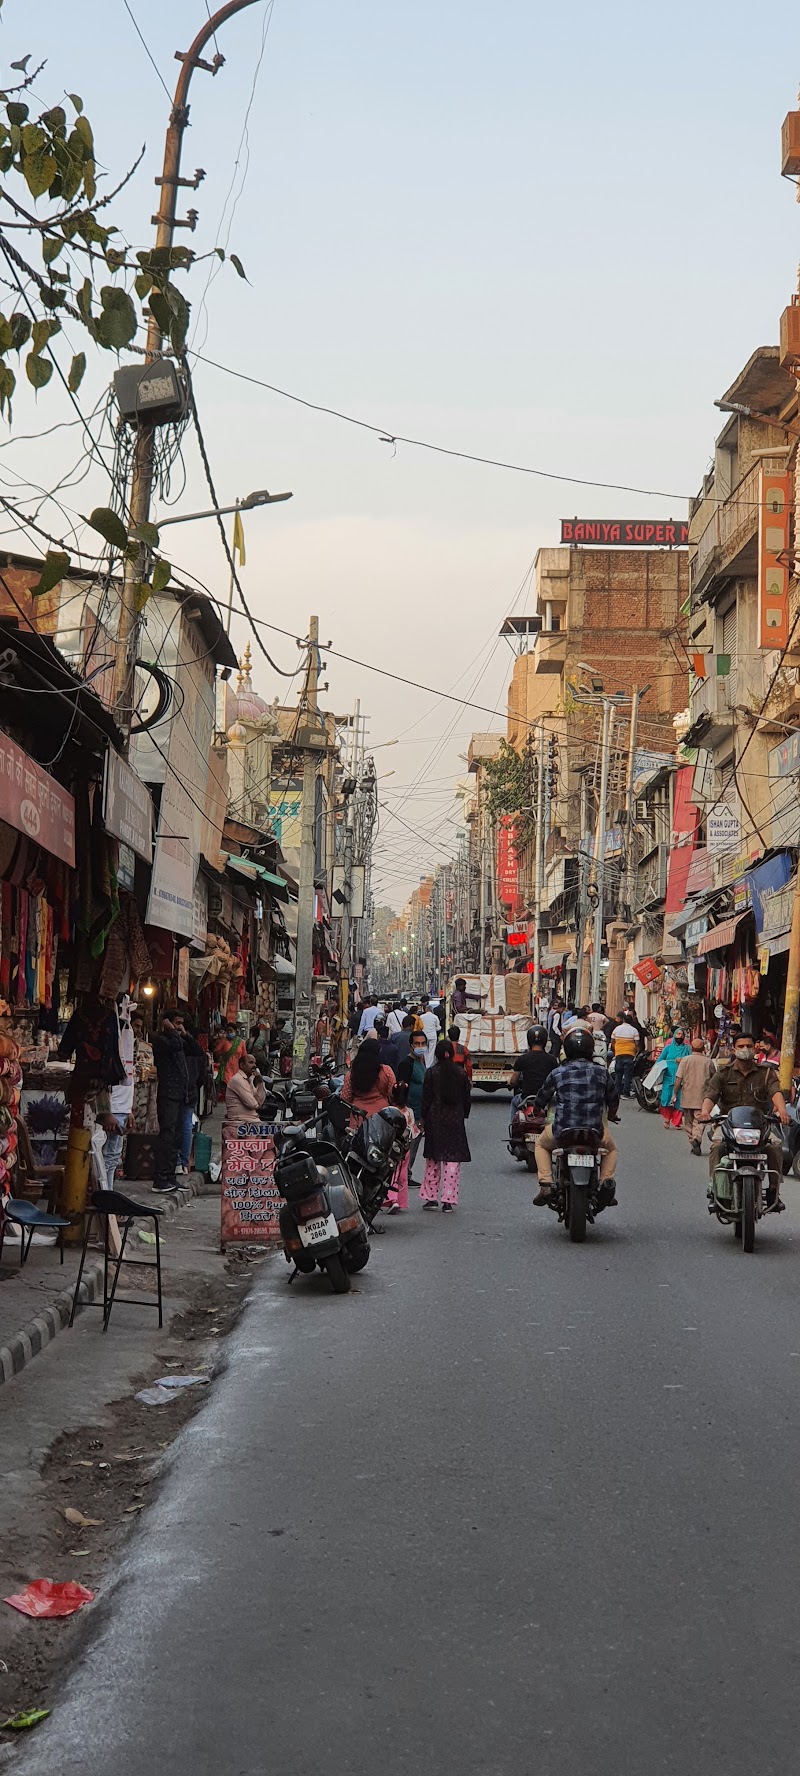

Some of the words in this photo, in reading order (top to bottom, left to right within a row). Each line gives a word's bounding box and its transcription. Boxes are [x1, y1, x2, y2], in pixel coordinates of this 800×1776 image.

[563, 522, 620, 541] BANIYA
[625, 524, 675, 542] SUPER
[709, 819, 723, 828] ISHAN
[724, 819, 739, 828] GUPTA
[714, 829, 739, 837] ASSOCIATES
[225, 1139, 271, 1156] गुप्ता
[226, 1156, 258, 1172] मेवे
[224, 1186, 246, 1198] और
[232, 1200, 263, 1210] 100%
[304, 1219, 329, 1233] JK02AP
[310, 1228, 327, 1240] 2868
